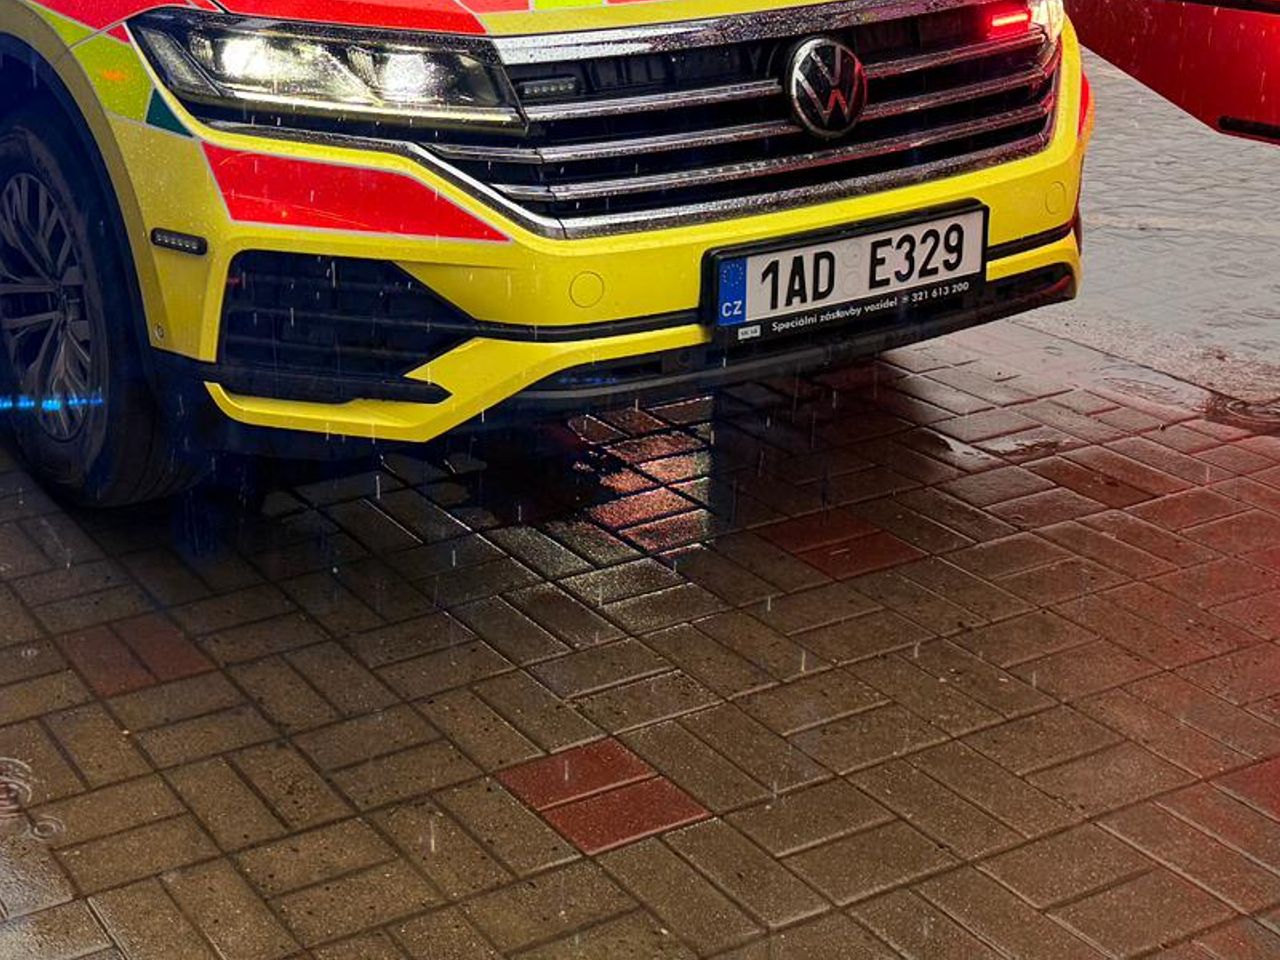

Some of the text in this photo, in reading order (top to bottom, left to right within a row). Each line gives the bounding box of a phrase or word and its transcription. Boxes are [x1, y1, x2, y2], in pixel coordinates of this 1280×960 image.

[722, 223, 965, 317] CZ 1AD E329
[772, 313, 818, 332] Speciální
[864, 298, 898, 316] vozidel
[911, 291, 929, 304] 321
[931, 286, 949, 299] 613
[951, 281, 970, 293] 200
